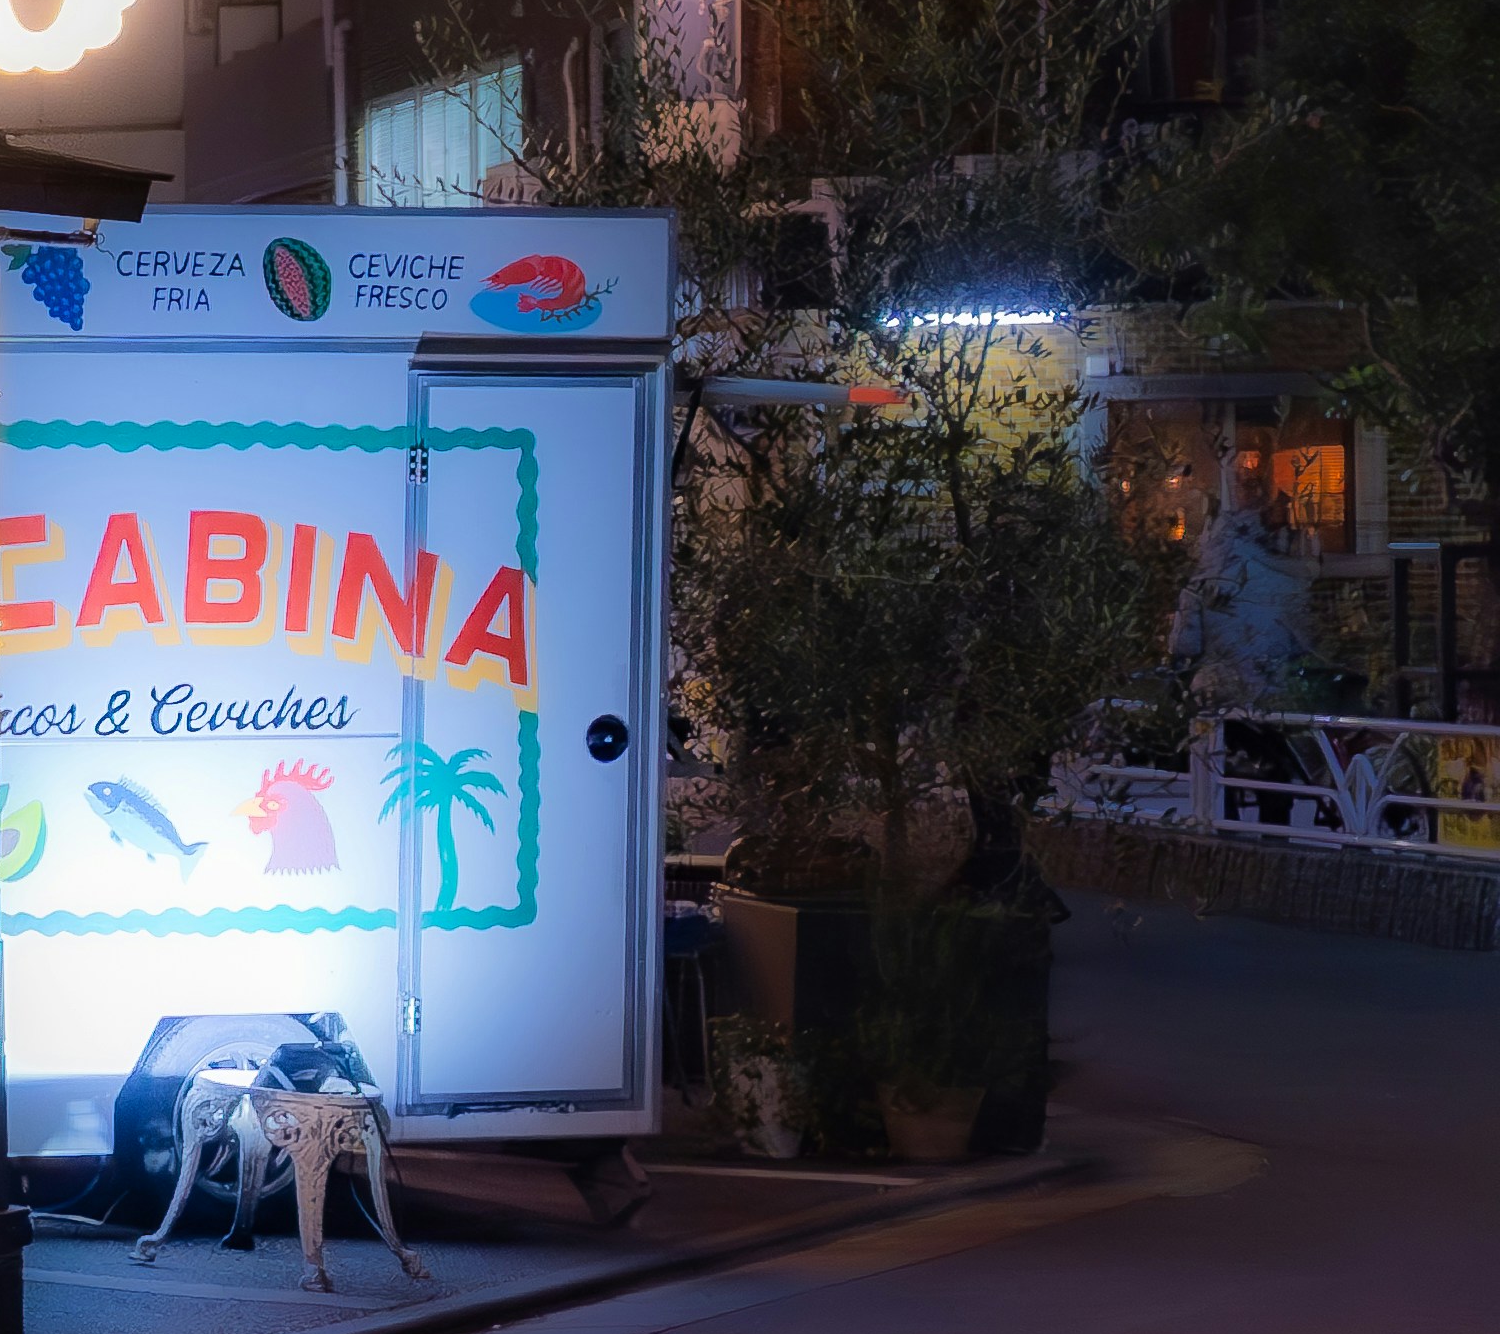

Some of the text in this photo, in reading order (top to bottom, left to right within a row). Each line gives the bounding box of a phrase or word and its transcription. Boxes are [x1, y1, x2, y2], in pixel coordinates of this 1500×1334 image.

[115, 250, 246, 282] CERVEZA
[348, 252, 465, 282] CEVICHE
[151, 285, 212, 313] FRIA
[354, 285, 449, 312] FRESCO
[94, 688, 132, 737] &
[150, 681, 360, 735] Ceviches
